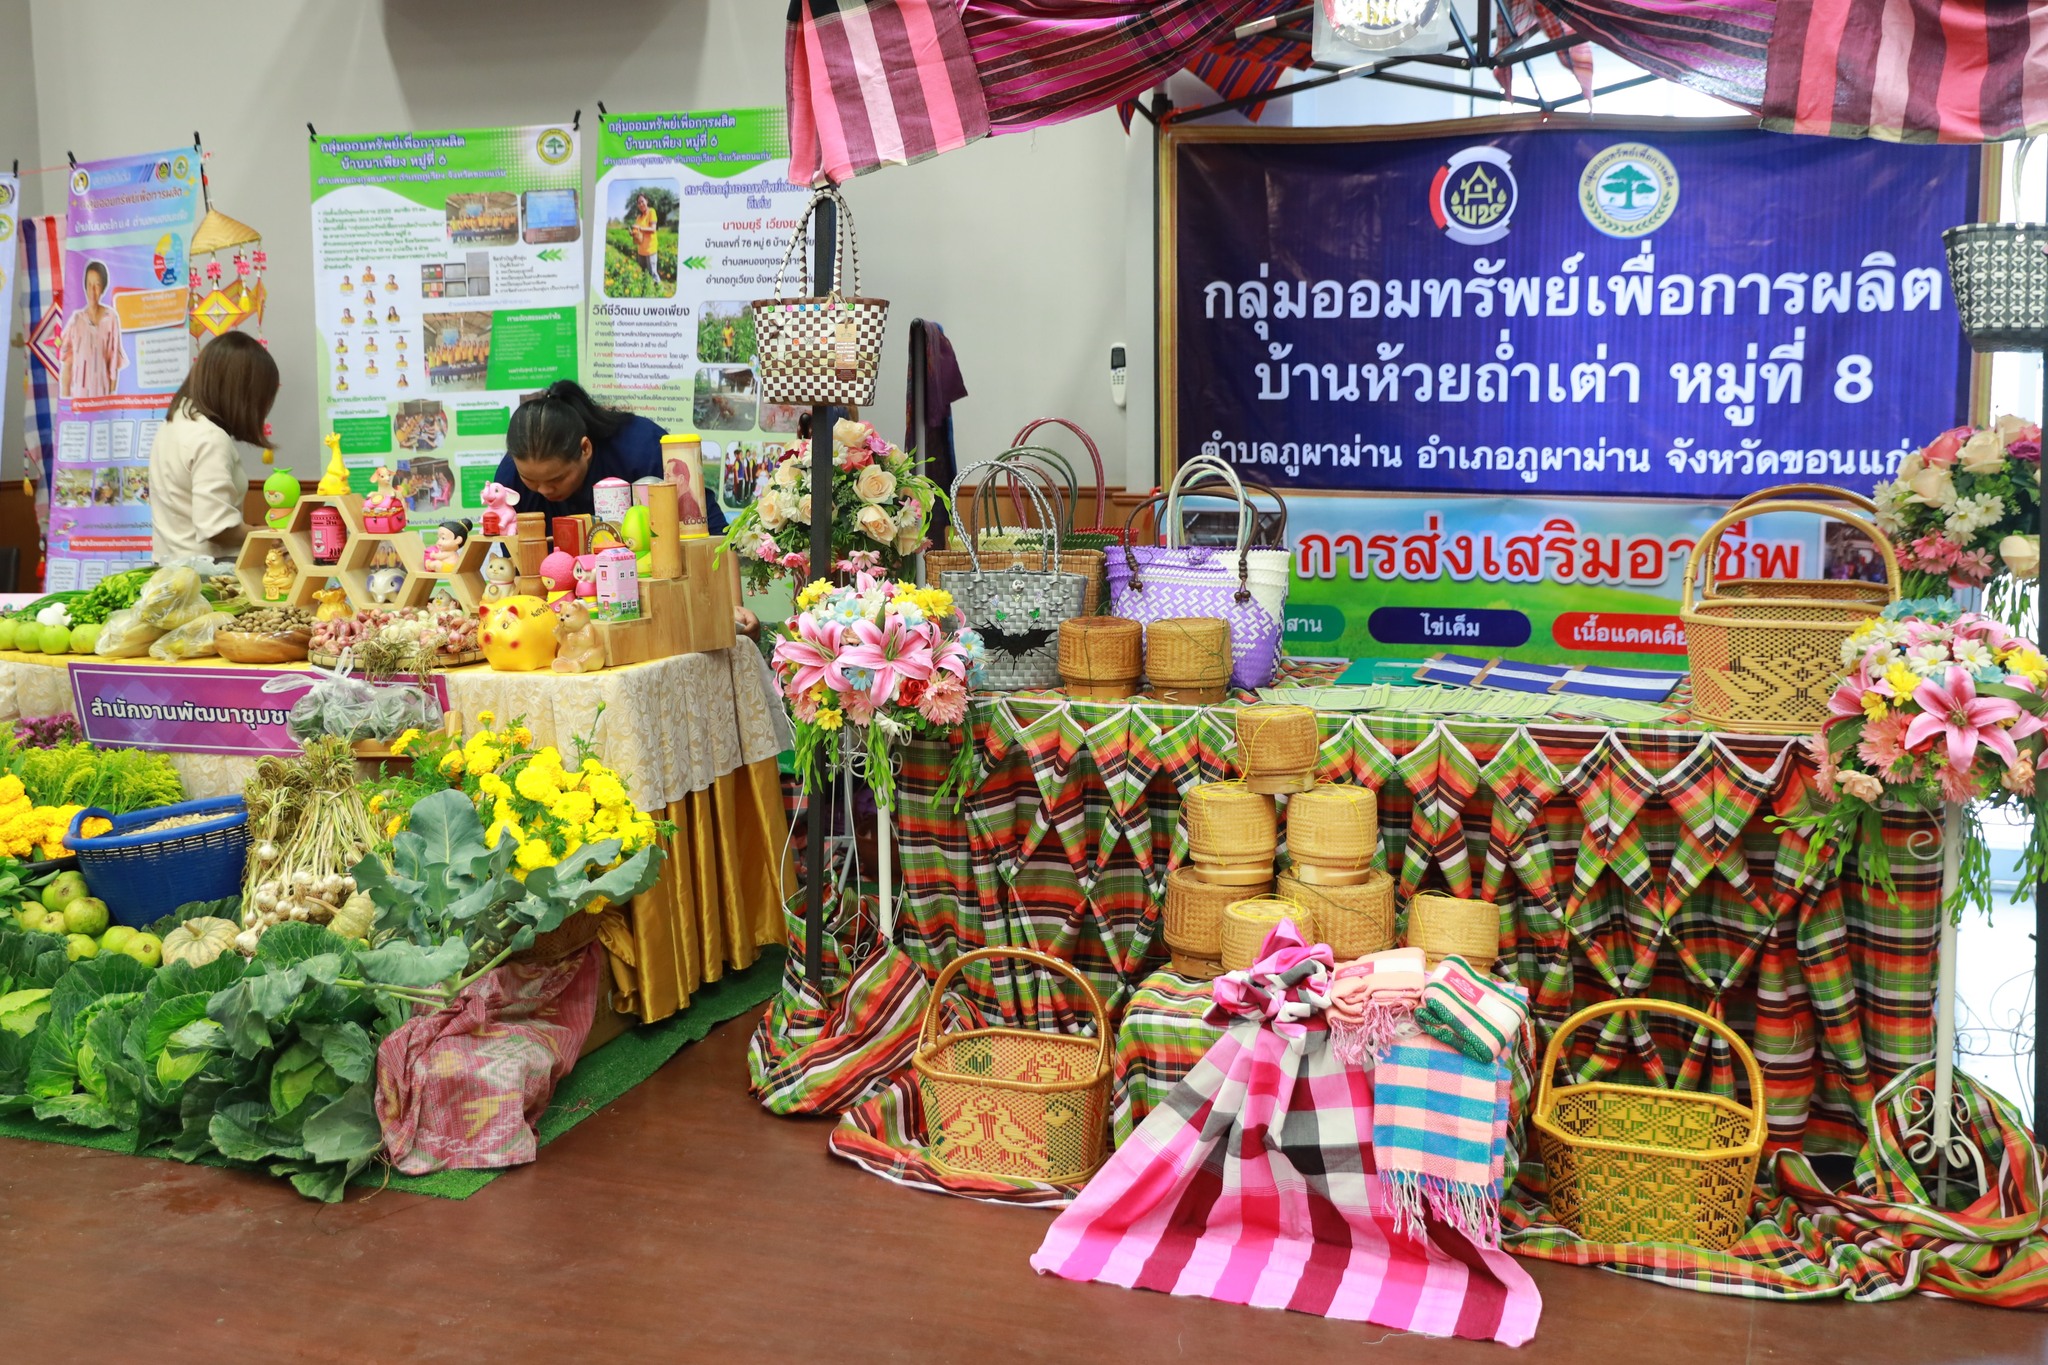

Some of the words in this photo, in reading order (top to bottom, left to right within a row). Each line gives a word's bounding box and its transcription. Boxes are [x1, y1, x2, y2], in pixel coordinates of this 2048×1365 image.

[607, 113, 736, 134] กลุ่มออมทรัพย์เพื่อการผลิต
[320, 132, 466, 158] กลุ่มออมทรัพย์เพื่อการผลิต
[625, 136, 682, 151] บ้านนาเพียง
[685, 130, 708, 153] หมู่ที่
[710, 136, 718, 148] 6
[340, 154, 408, 172] บ้านนาเพียง
[410, 151, 437, 171] หมู่ที่
[438, 155, 448, 167] 6
[722, 217, 762, 233] นางมยุรี
[765, 217, 797, 230] เวียงย
[704, 234, 740, 249] บ้านเลขที่
[741, 239, 753, 249] 76
[753, 237, 766, 251] หมู่
[766, 239, 772, 248] 6
[705, 273, 755, 290] อำเภอภูเวียง
[1203, 239, 1943, 341] กลุ่มออมทรัพย์เพื่อการผลิต
[592, 303, 640, 317] วิถีชีวิตแบ
[642, 303, 690, 317] บพอเพียง
[1668, 325, 1806, 428] หมู่ที่
[1833, 353, 1875, 404] 8
[1200, 430, 1403, 477] ตำบลภูผาม่าน
[1416, 434, 1651, 484] อำเภอภูผาม่าน
[1665, 437, 1920, 476] จังหวัดขอนแก่
[1283, 616, 1324, 634] สาน
[1420, 612, 1481, 638] ไข่เค็ม
[1572, 613, 1689, 647] เนื้อแดดเดีย
